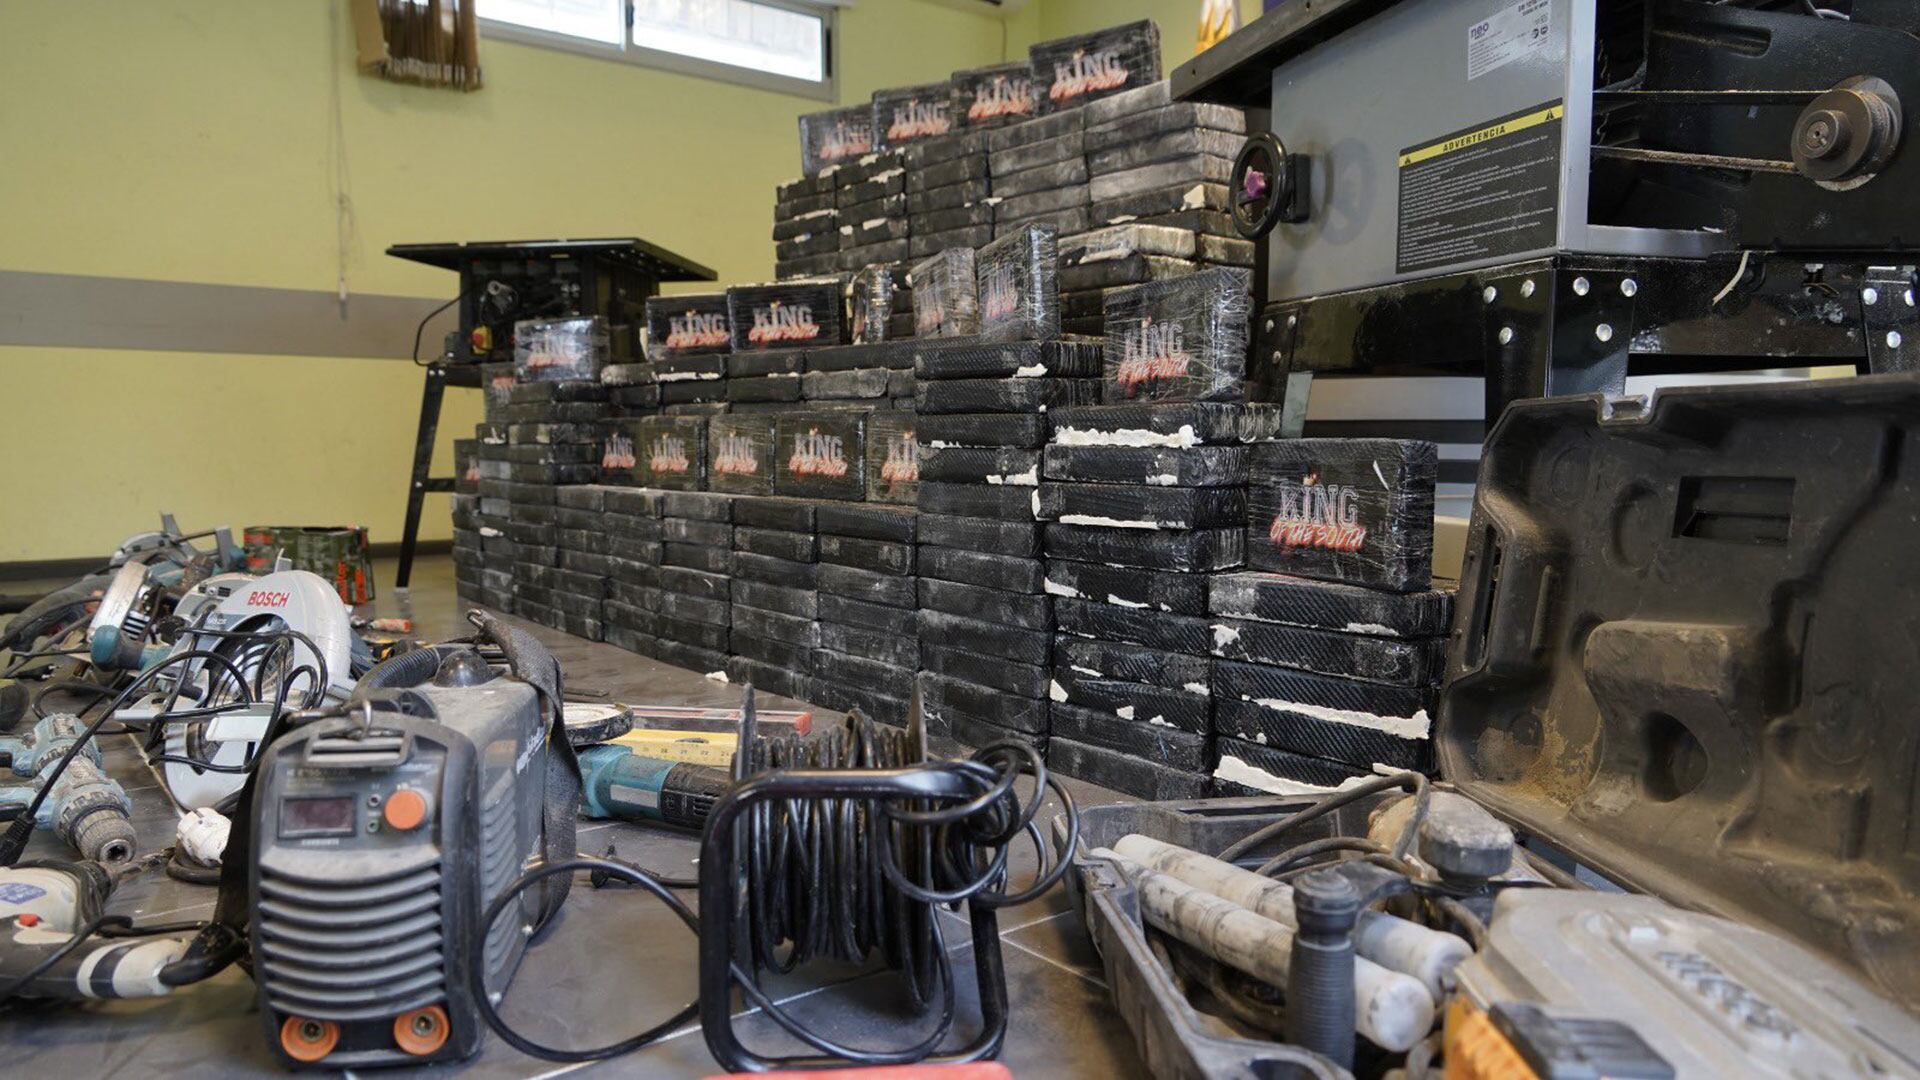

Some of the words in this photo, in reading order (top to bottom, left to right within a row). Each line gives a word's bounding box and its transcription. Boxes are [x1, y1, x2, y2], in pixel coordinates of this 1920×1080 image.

[1470, 22, 1489, 39] neo
[1054, 50, 1121, 83] KING
[893, 101, 949, 125] KING
[1442, 125, 1506, 152] ADVERTENCIA
[669, 313, 726, 337] KING
[753, 304, 813, 329] KING
[1124, 320, 1184, 362] KING
[605, 437, 633, 456] KING
[795, 432, 843, 462] KING
[1279, 482, 1359, 527] KING
[1270, 520, 1288, 542] OF
[1314, 524, 1367, 549] SOUTH
[247, 591, 290, 607] BOSCH
